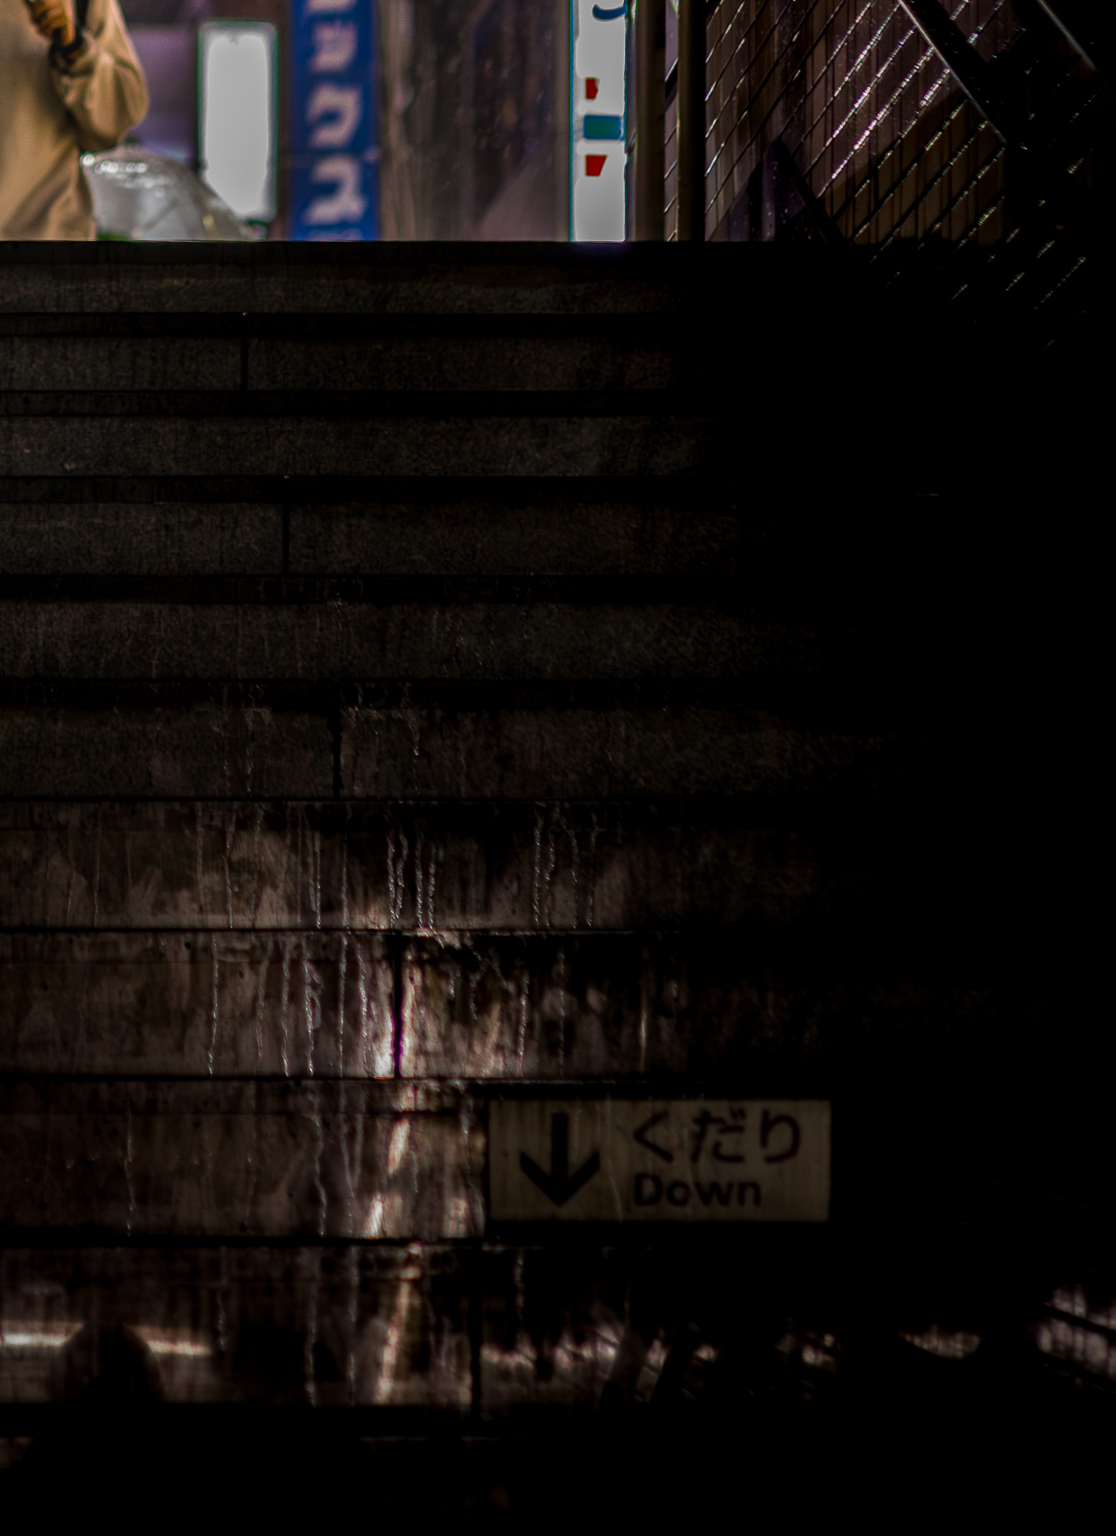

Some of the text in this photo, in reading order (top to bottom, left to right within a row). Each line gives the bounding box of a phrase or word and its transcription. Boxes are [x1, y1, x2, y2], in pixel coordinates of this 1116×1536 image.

[634, 1108, 800, 1164] くだり
[634, 1173, 762, 1208] Down
